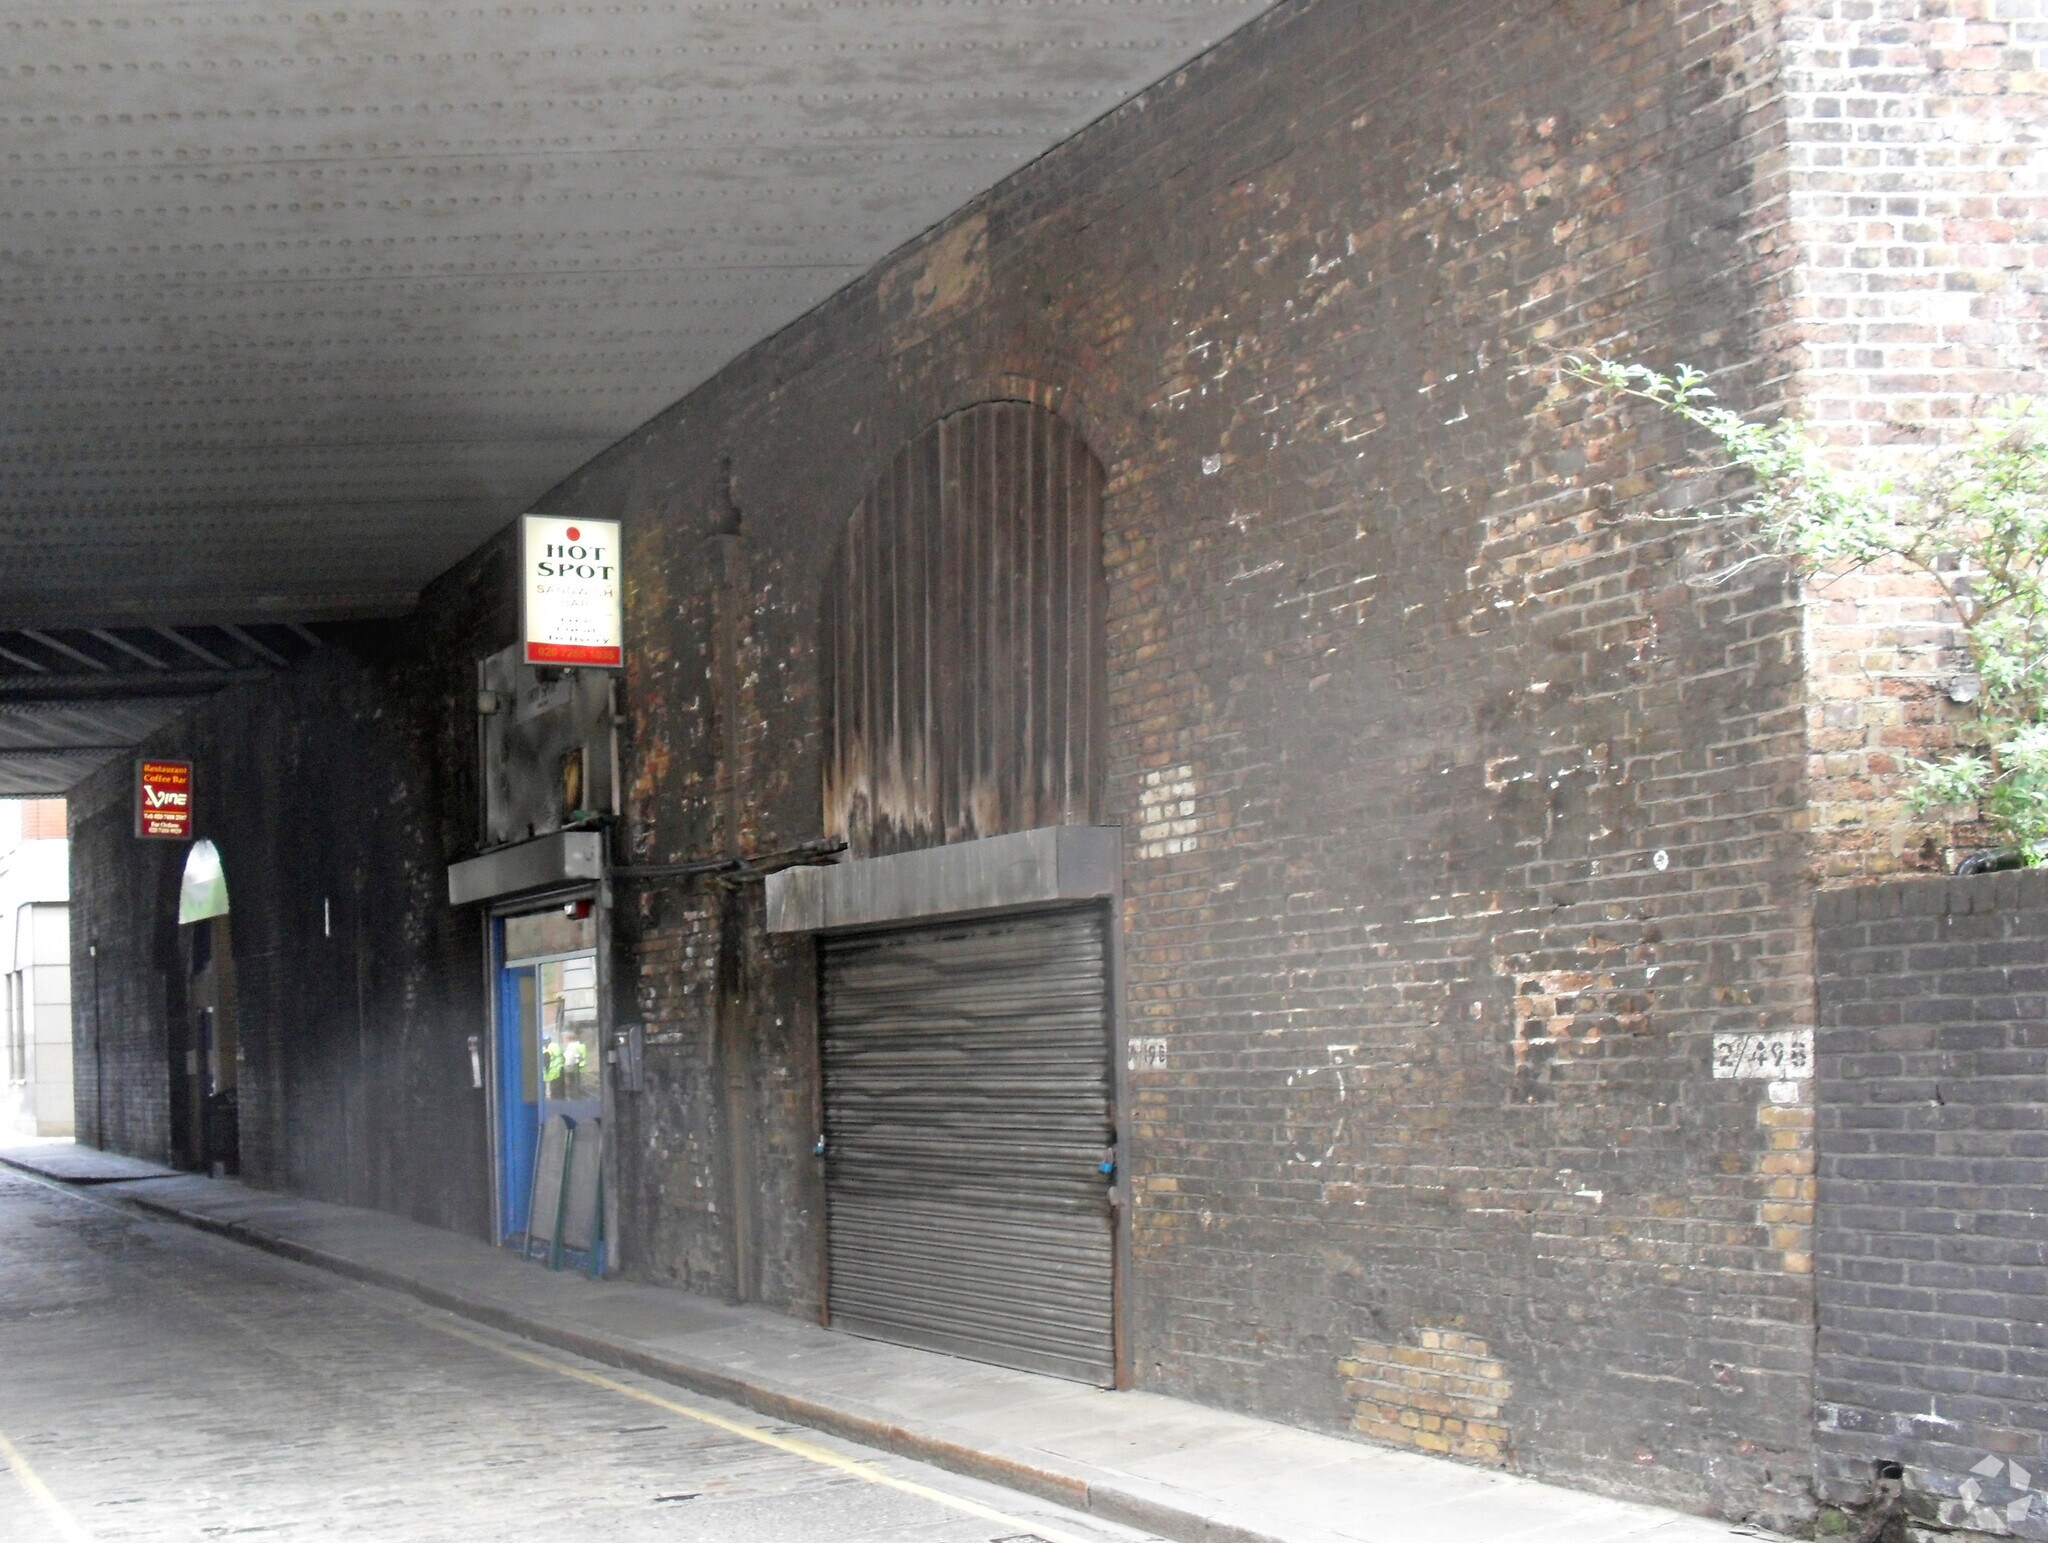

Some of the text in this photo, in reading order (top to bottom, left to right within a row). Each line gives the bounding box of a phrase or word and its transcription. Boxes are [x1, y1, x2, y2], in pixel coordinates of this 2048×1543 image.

[547, 544, 606, 561] HOT
[537, 562, 614, 580] SPOT
[144, 765, 187, 773] Restaurant
[144, 774, 187, 784] Coffee Bar
